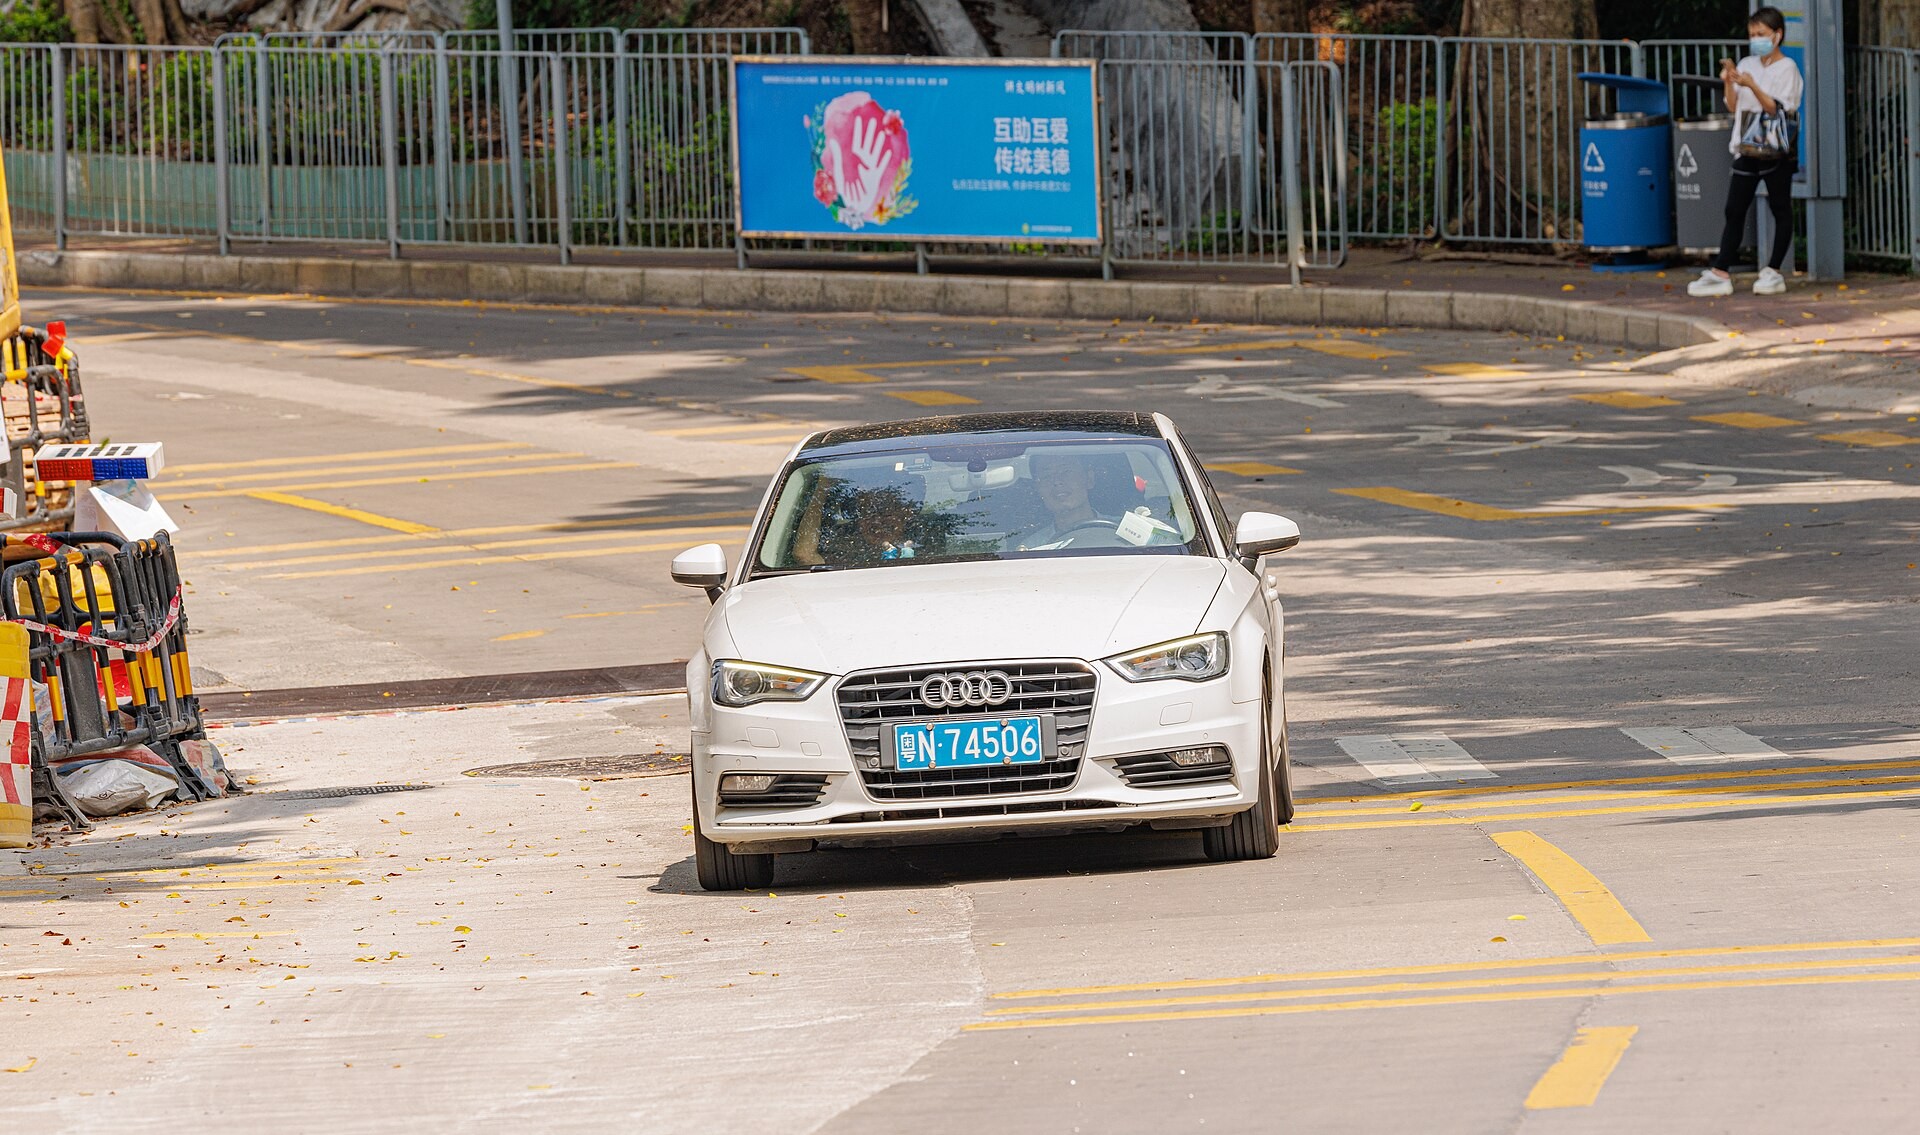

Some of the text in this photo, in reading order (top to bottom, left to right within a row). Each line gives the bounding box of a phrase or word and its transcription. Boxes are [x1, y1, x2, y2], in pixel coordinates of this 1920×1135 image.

[1005, 80, 1066, 95] 讲文明树新风
[993, 116, 1069, 144] 互助互爱
[994, 146, 1071, 175] 传统美德
[900, 725, 1038, 763] 粤N·74506
